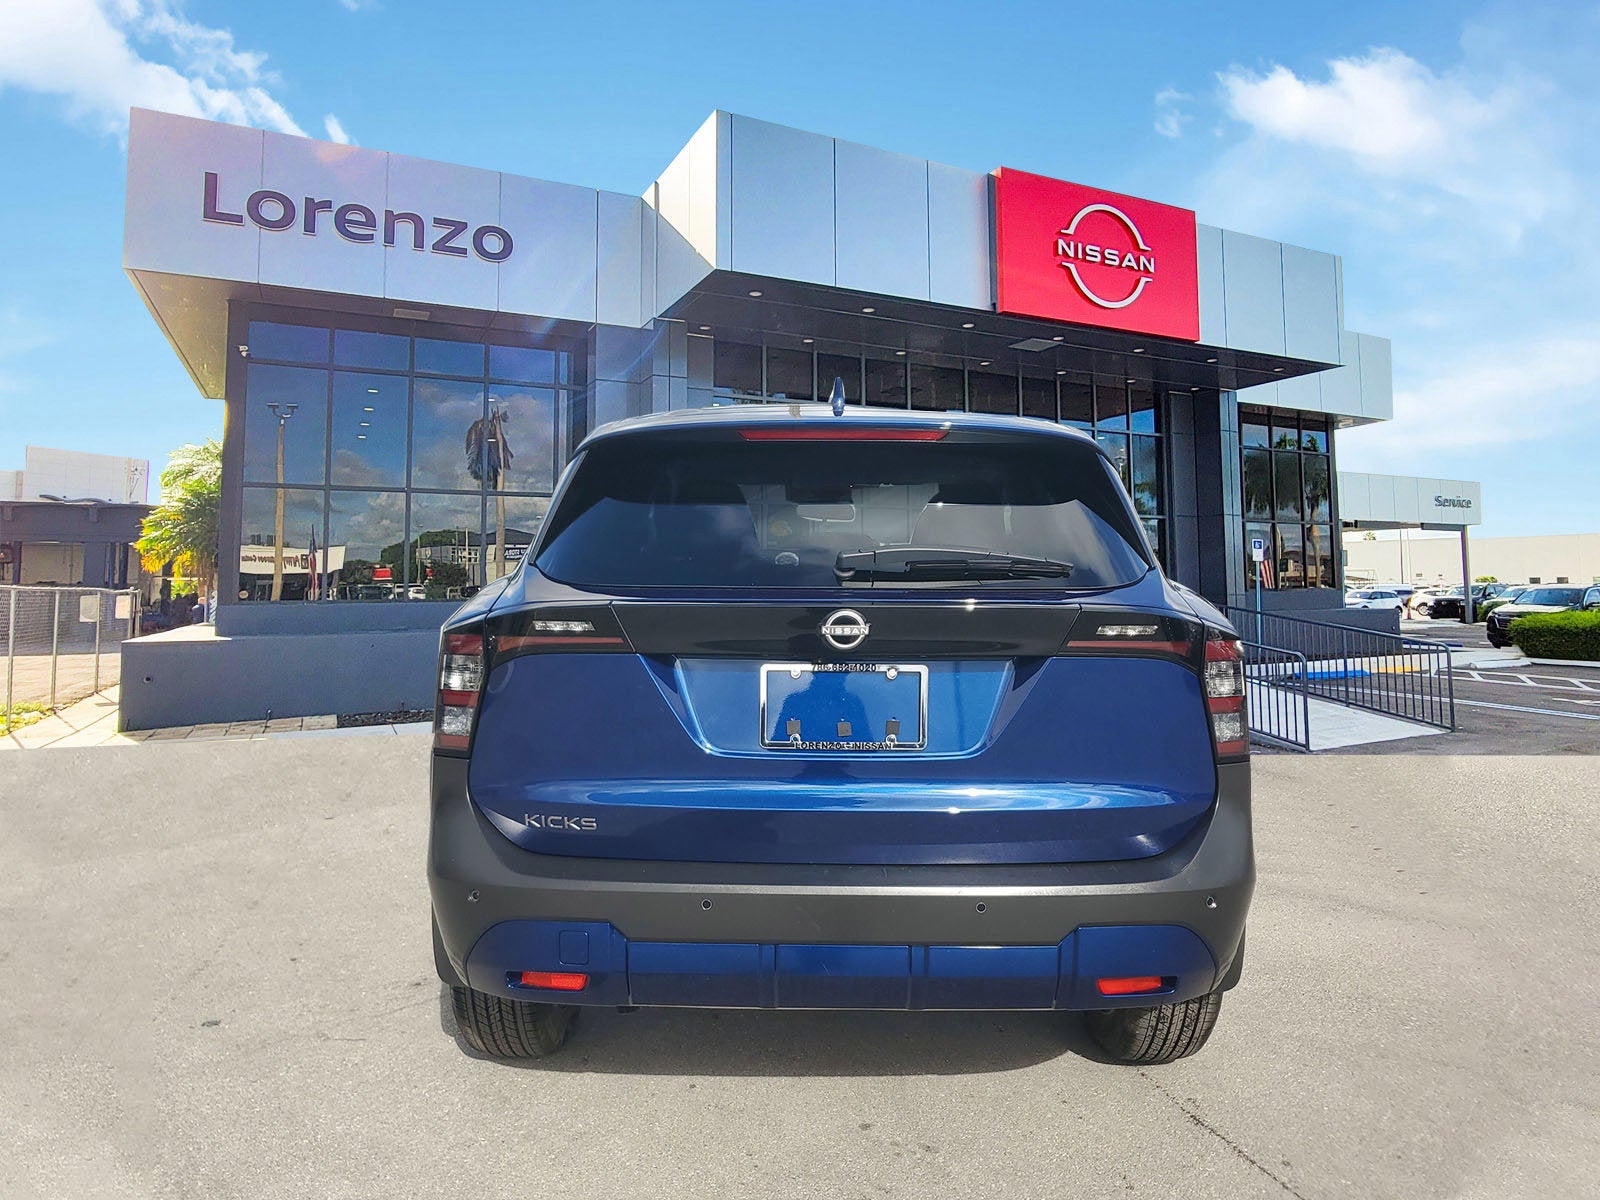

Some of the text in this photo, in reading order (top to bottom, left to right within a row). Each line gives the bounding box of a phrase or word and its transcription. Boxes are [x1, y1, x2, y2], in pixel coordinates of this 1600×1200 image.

[203, 171, 515, 263] Lorenzo
[1057, 237, 1155, 274] NISSAN
[1434, 495, 1472, 508] Service
[821, 626, 869, 635] NISSAN
[795, 741, 893, 751] LORENZO NISSAN
[524, 813, 597, 831] KICKS
